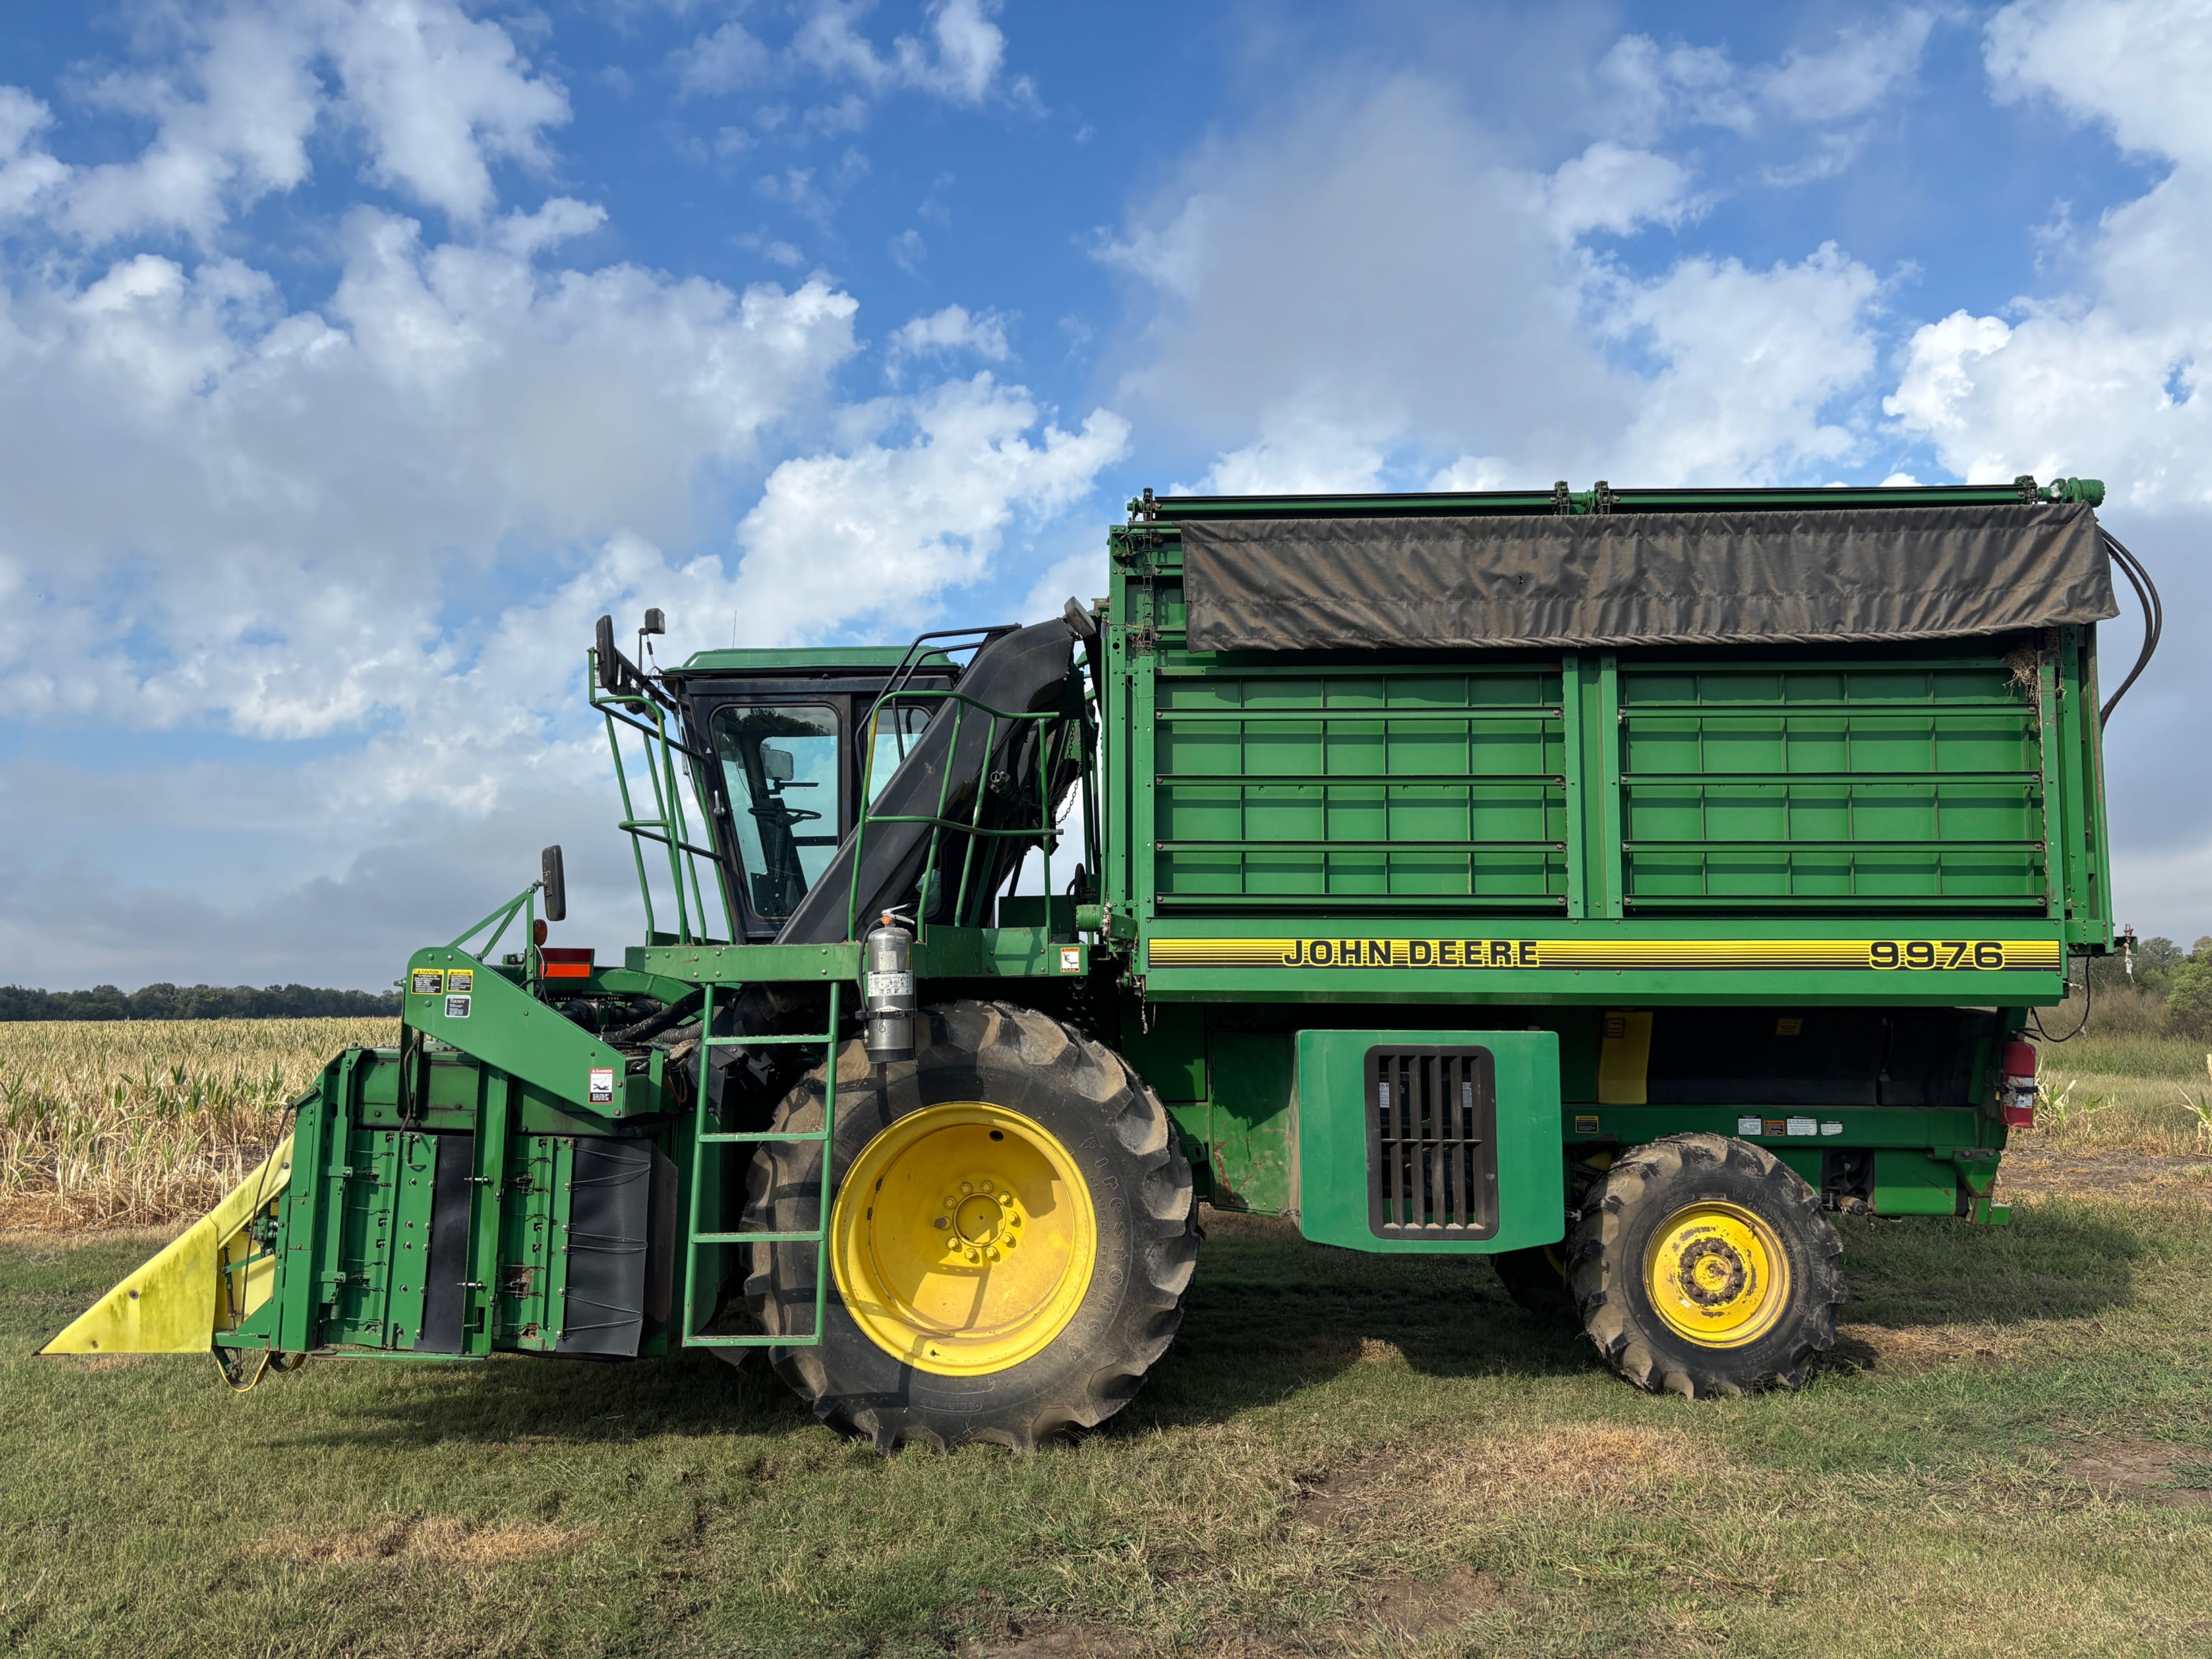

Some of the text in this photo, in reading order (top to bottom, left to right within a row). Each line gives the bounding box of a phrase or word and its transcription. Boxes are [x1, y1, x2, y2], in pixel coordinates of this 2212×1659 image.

[1283, 940, 1539, 967] JOHN DEERE
[1870, 941, 2005, 969] 9976
[1089, 1176, 1110, 1236] CHAMPION
[1079, 1131, 1128, 1337] Firestone
[1748, 1202, 1782, 1234] CHAMPION
[1782, 1236, 1797, 1264] SPADE
[1095, 1245, 1108, 1285] SPADE
